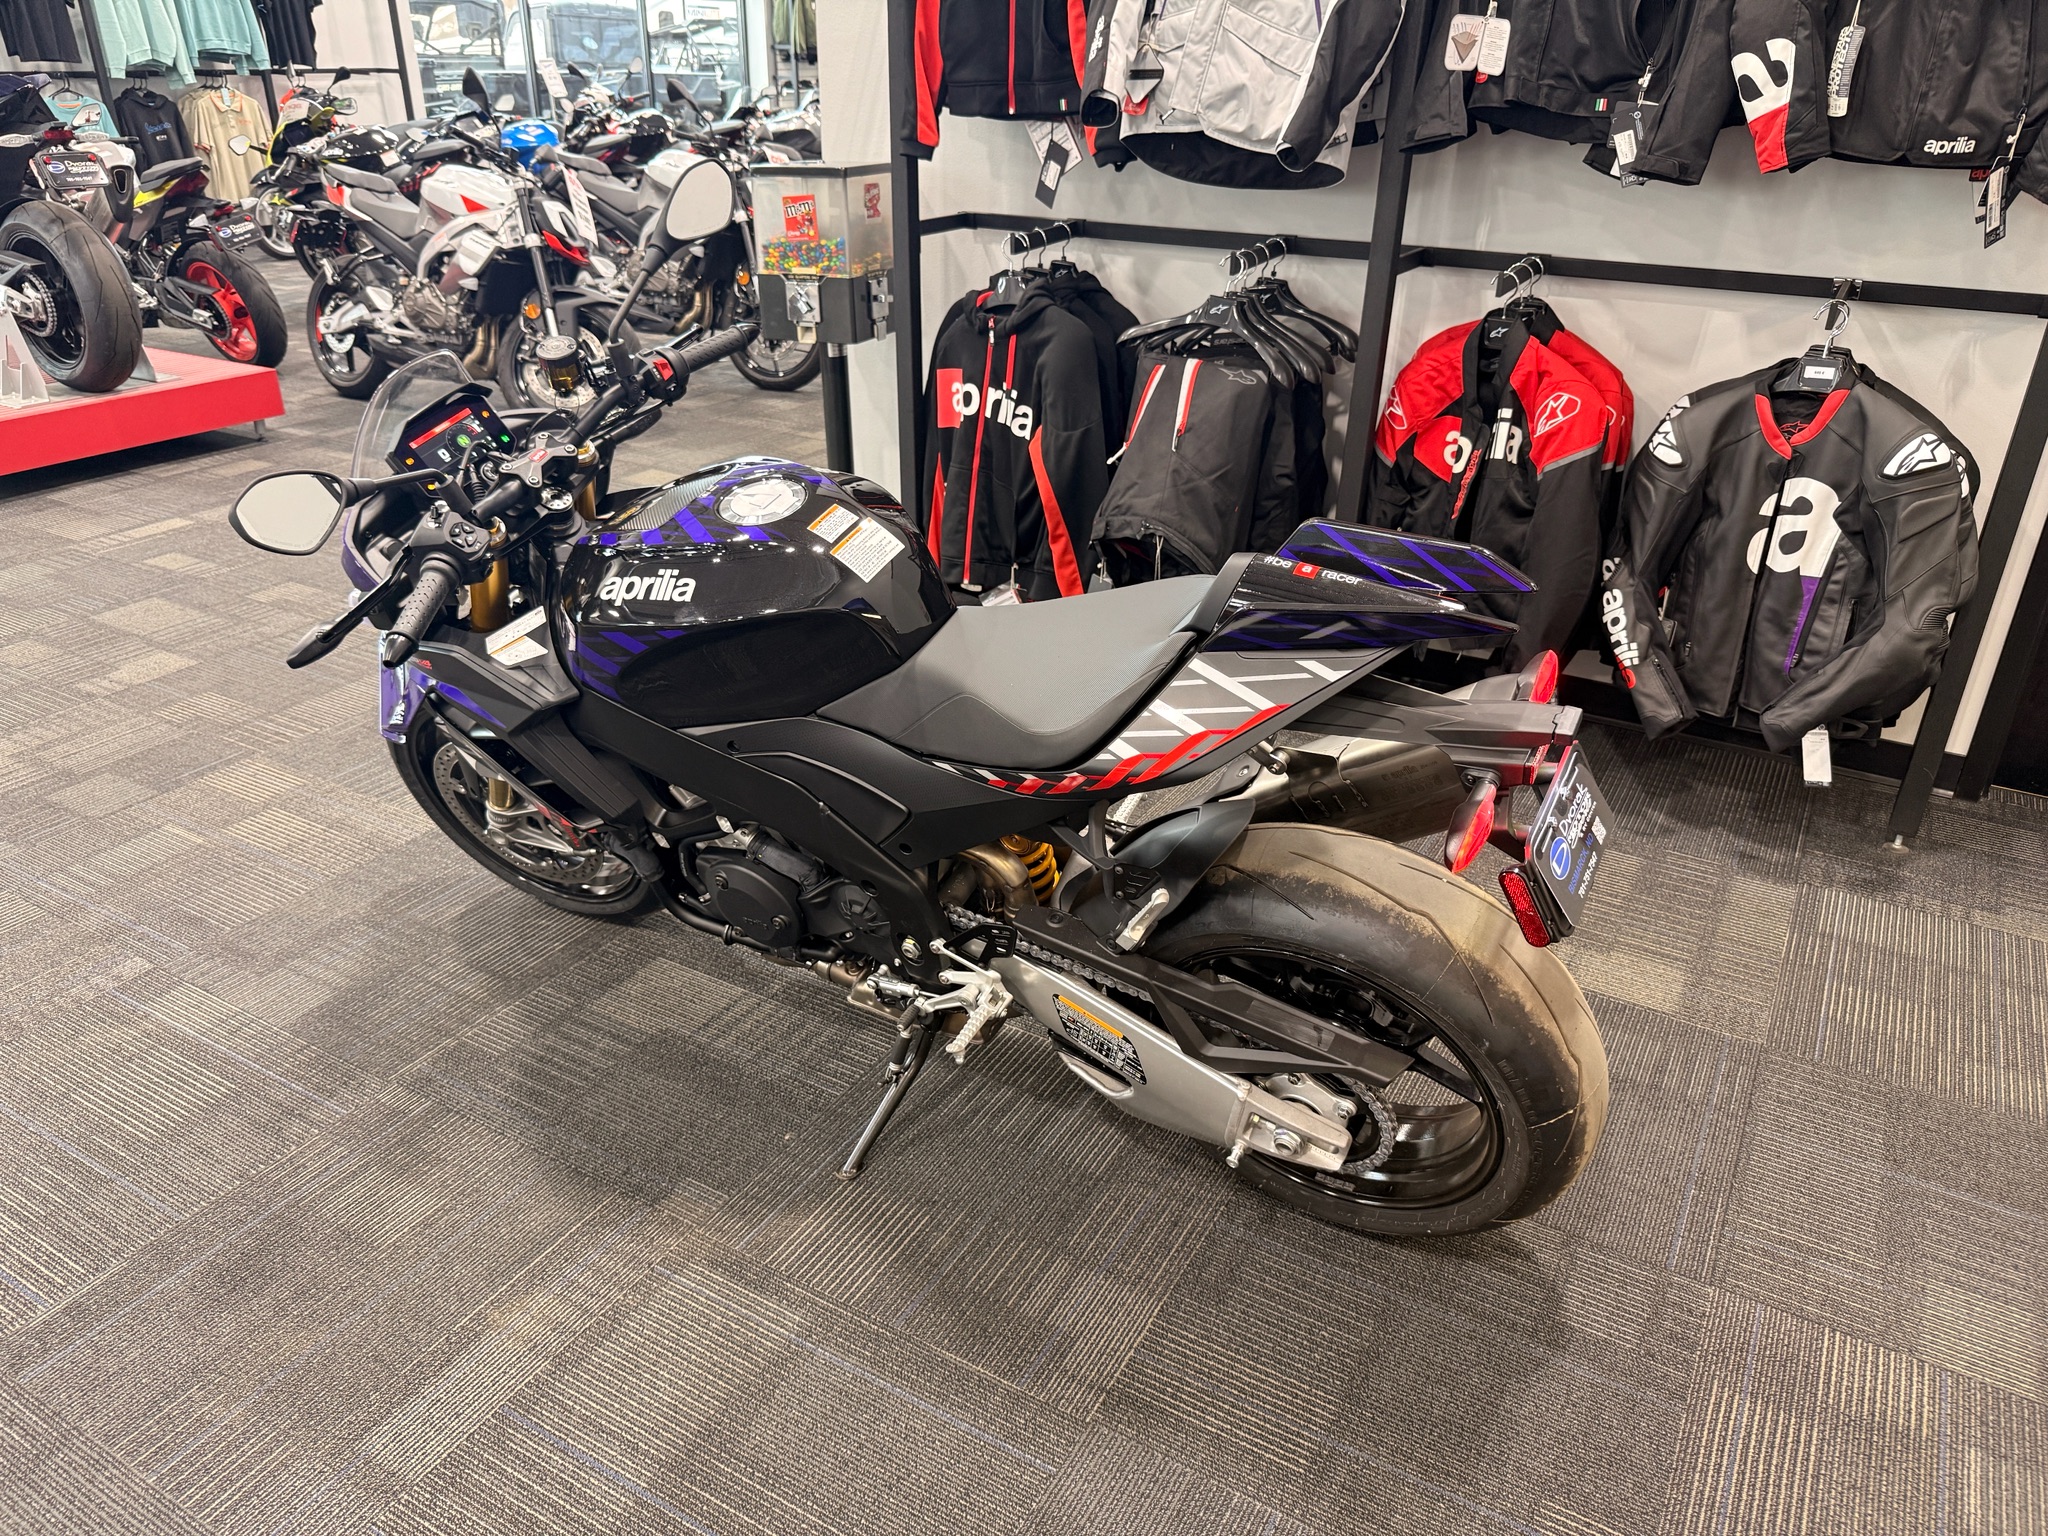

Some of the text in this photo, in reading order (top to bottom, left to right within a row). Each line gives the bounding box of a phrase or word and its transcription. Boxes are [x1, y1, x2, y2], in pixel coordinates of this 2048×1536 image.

[1923, 136, 1976, 156] aprilia
[600, 568, 697, 607] aprilia
[1264, 556, 1363, 585] #be a racer
[1559, 782, 1588, 837] Dvorak
[1568, 832, 1594, 895] BISMARCK, ND
